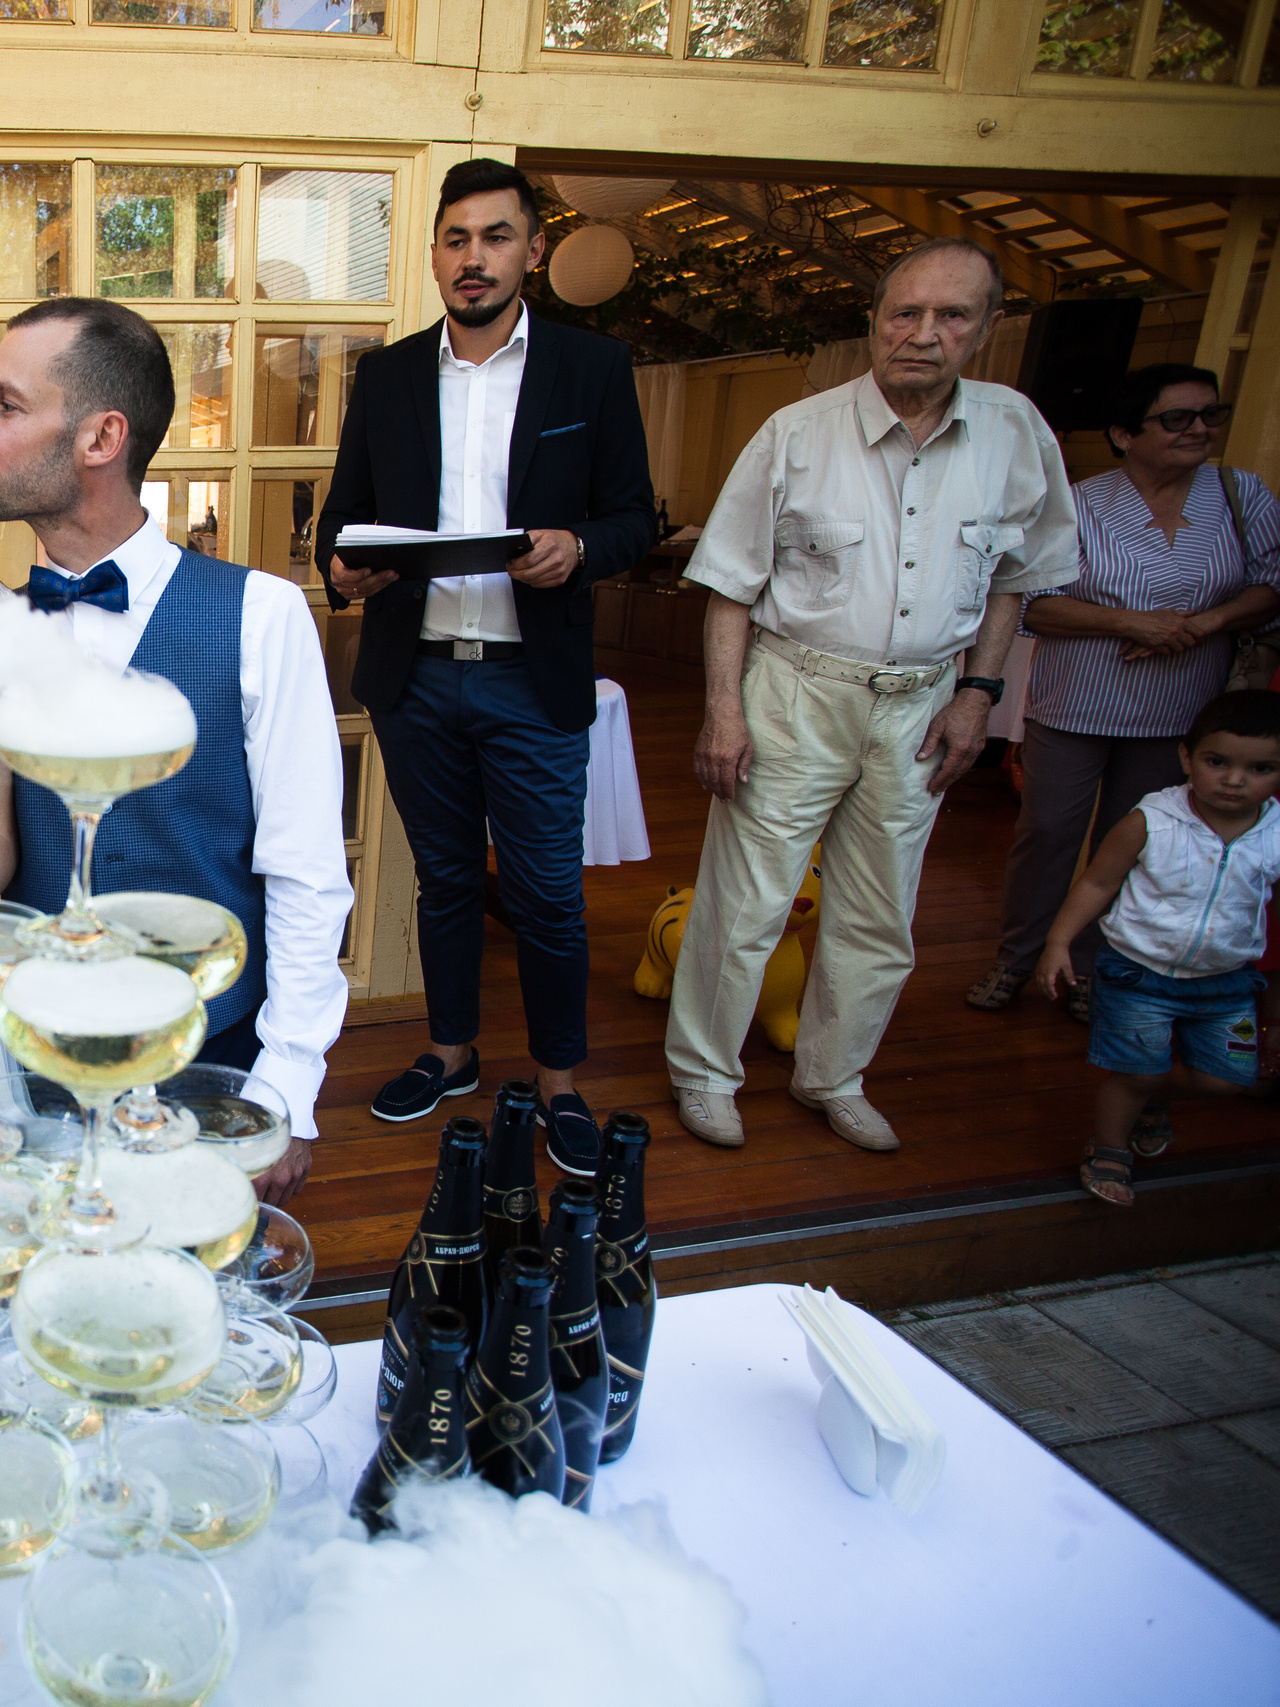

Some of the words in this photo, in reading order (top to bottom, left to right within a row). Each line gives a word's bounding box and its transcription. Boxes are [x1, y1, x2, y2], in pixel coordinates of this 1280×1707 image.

[434, 1243, 480, 1255] АБРАУ-ДЮРСО
[509, 1325, 531, 1377] 1870
[428, 1388, 452, 1445] 1870
